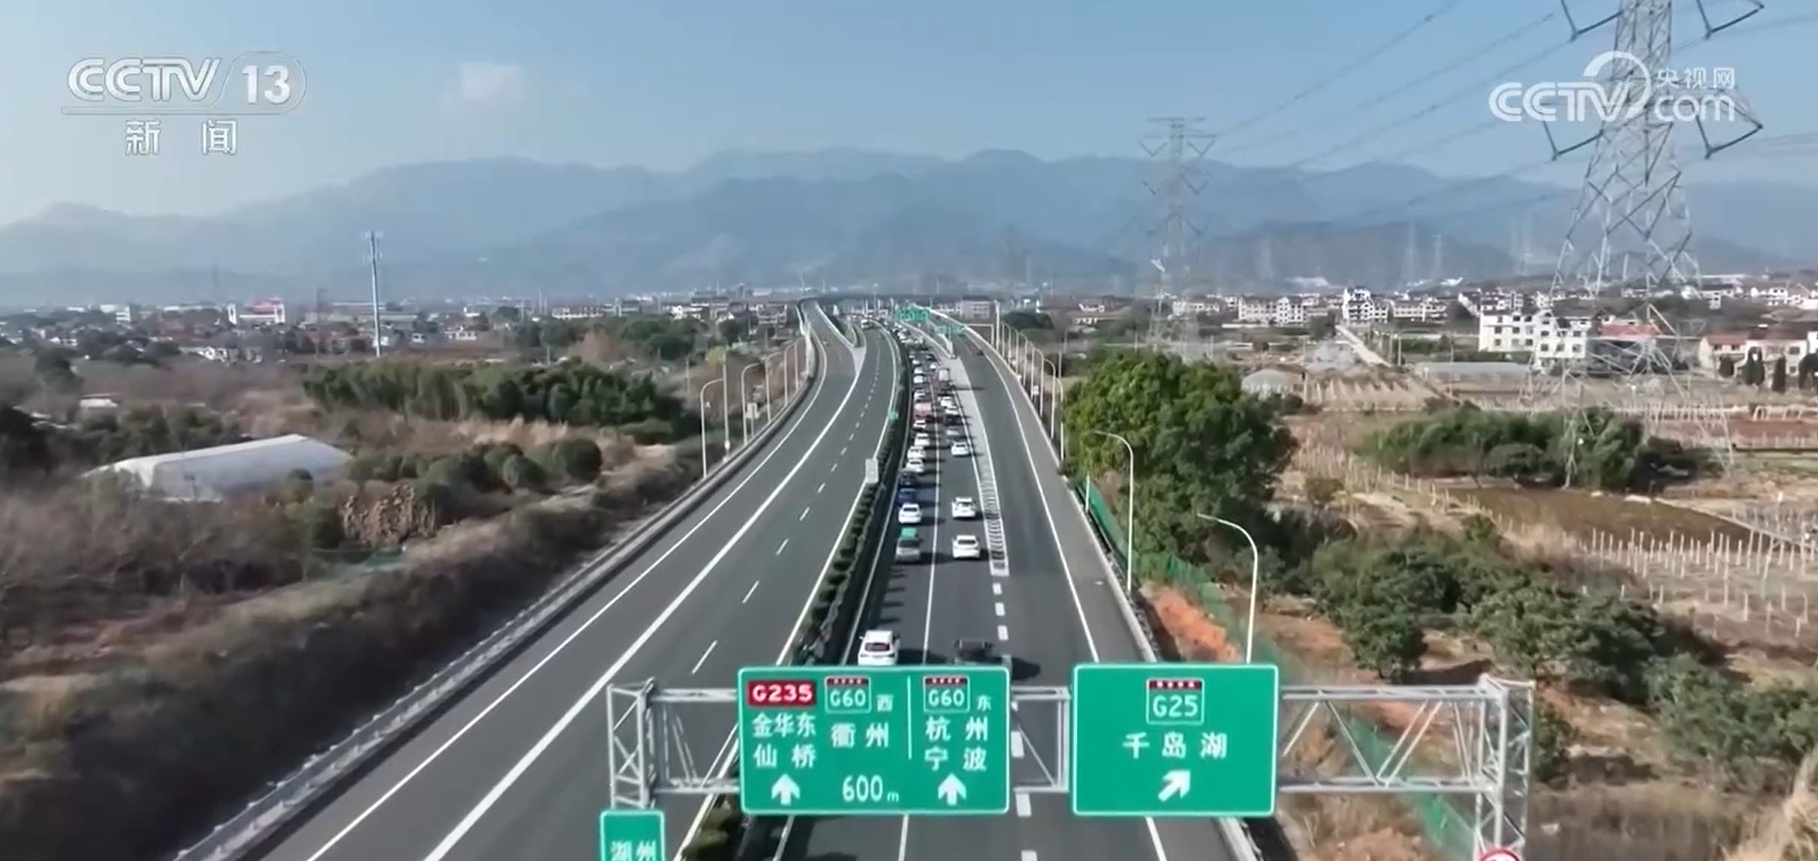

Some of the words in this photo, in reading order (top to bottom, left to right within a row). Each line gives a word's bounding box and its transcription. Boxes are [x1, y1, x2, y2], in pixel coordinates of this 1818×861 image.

[752, 684, 813, 702] G235
[830, 689, 866, 707] G60
[876, 694, 894, 712] 西
[928, 689, 965, 707] G60
[976, 695, 992, 711] 东
[1152, 694, 1199, 717] G25
[752, 712, 817, 738] 金华东
[831, 723, 889, 749] 衢州
[925, 716, 988, 742] 杭州
[752, 744, 817, 769] 仙桥
[1122, 731, 1228, 759] 千岛湖
[924, 747, 988, 772] 宁波
